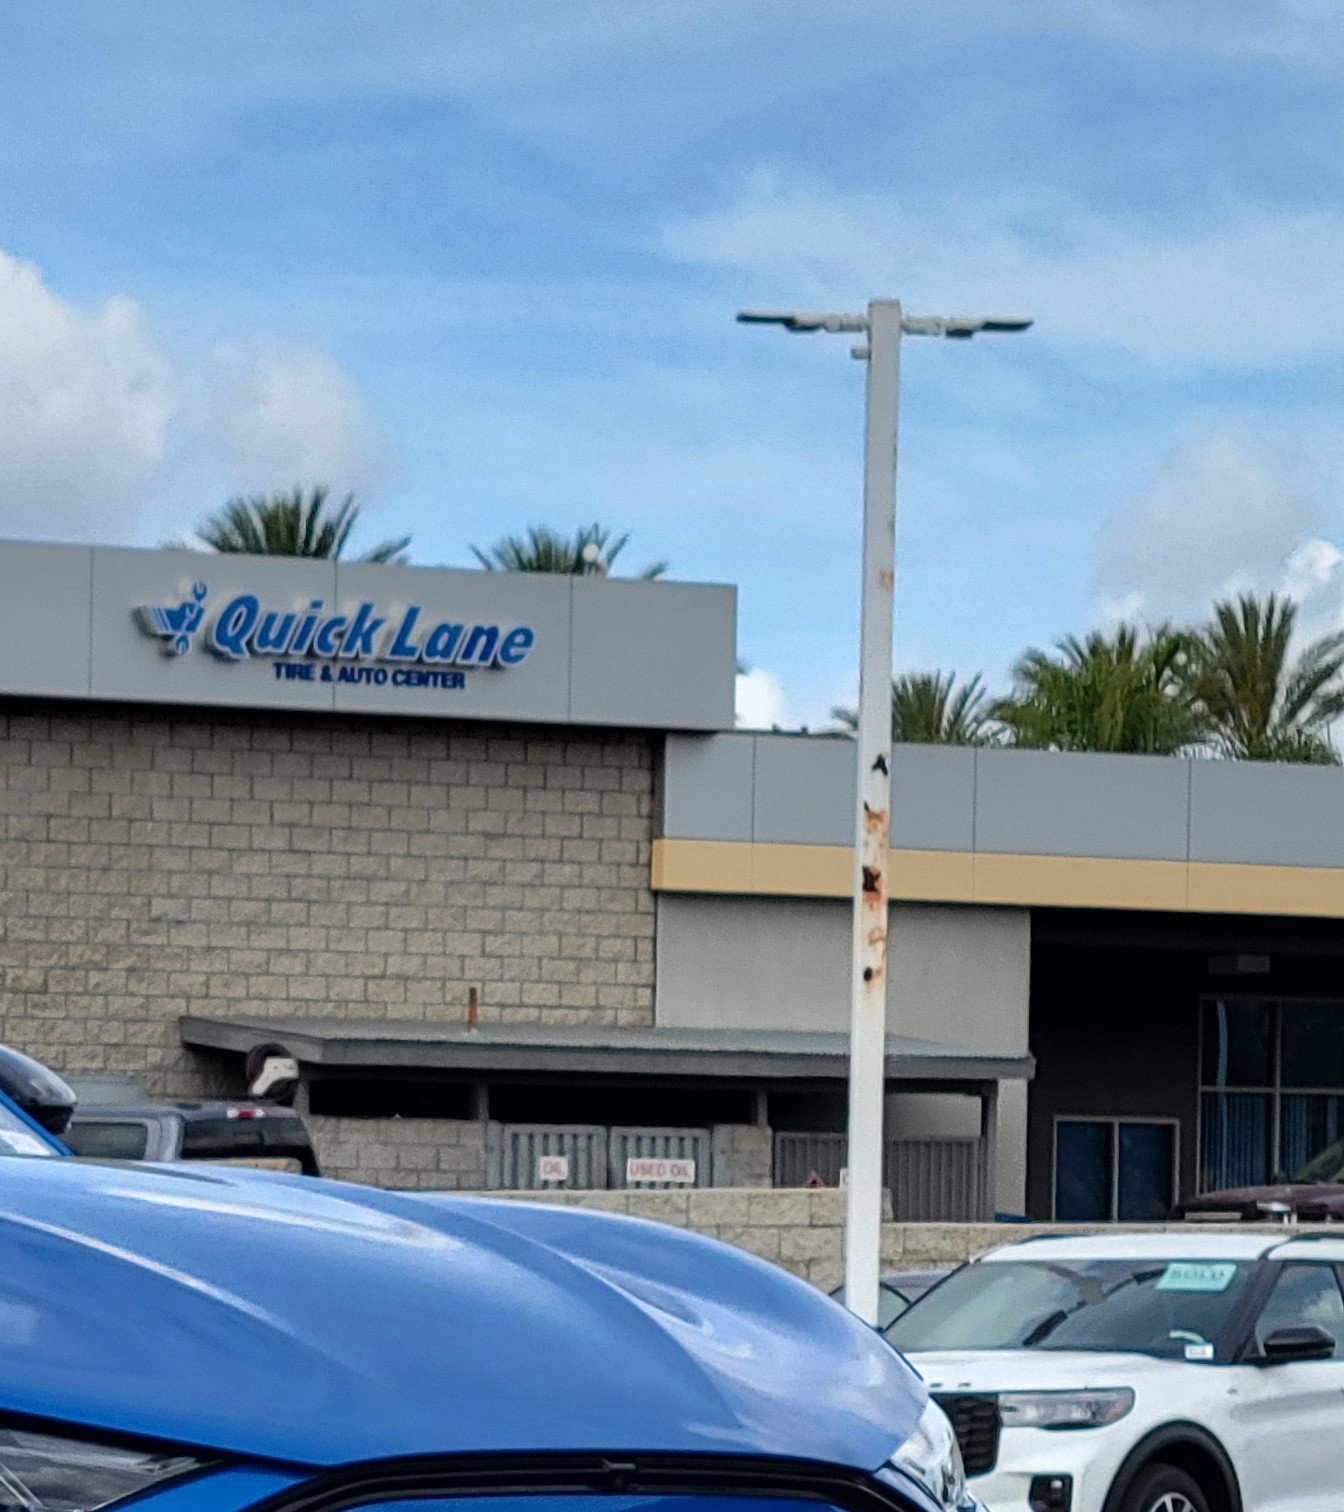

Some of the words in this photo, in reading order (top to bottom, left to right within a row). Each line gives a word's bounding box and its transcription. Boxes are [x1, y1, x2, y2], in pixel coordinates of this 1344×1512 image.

[213, 593, 385, 659] Quick
[385, 604, 536, 668] Lane
[272, 661, 316, 682] TIRE
[319, 664, 333, 683] &
[337, 666, 388, 686] AUTO
[391, 668, 466, 690] CENTER
